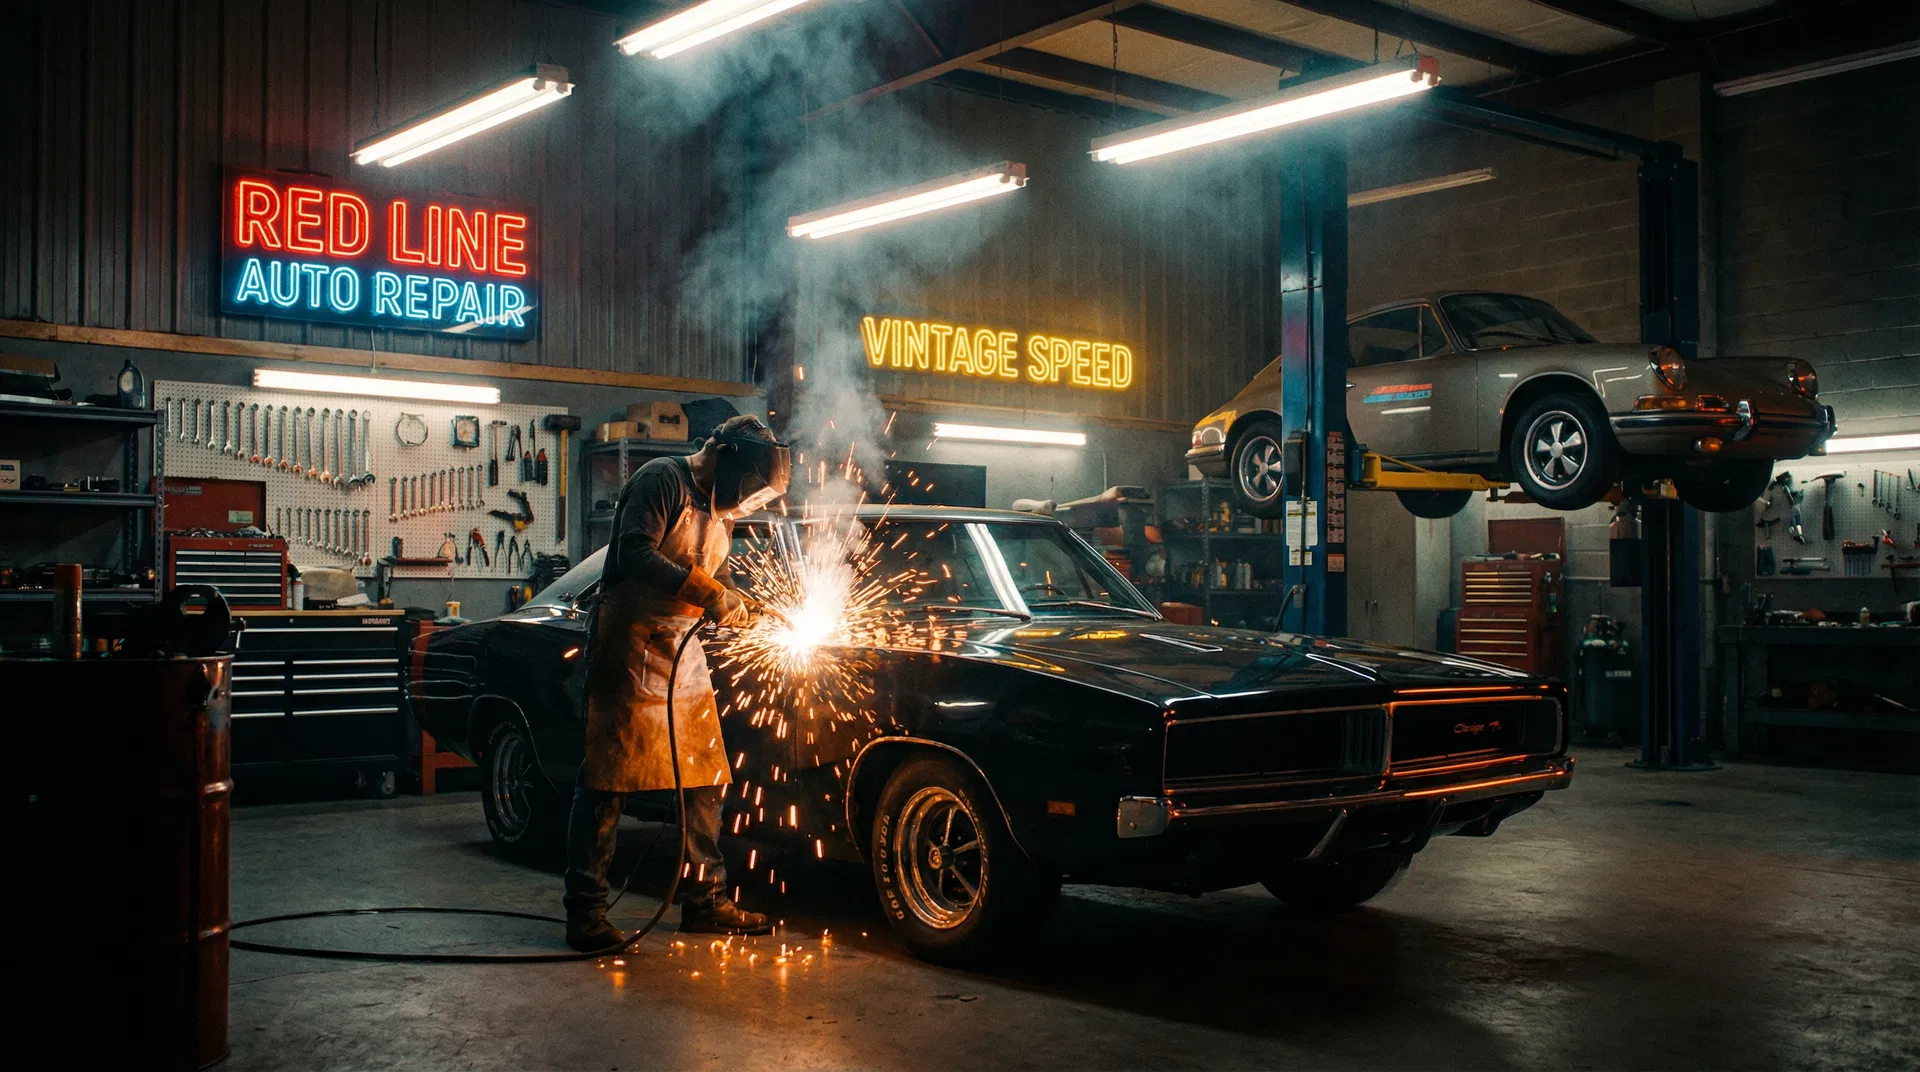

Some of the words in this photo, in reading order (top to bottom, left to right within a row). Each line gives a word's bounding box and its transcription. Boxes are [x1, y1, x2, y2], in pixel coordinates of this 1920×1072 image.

[234, 180, 371, 257] RED
[388, 201, 527, 275] LINE
[236, 258, 360, 312] AUTO
[373, 270, 526, 328] REPAIR
[861, 316, 1019, 378] VINTAGE
[1027, 334, 1133, 389] SPEED
